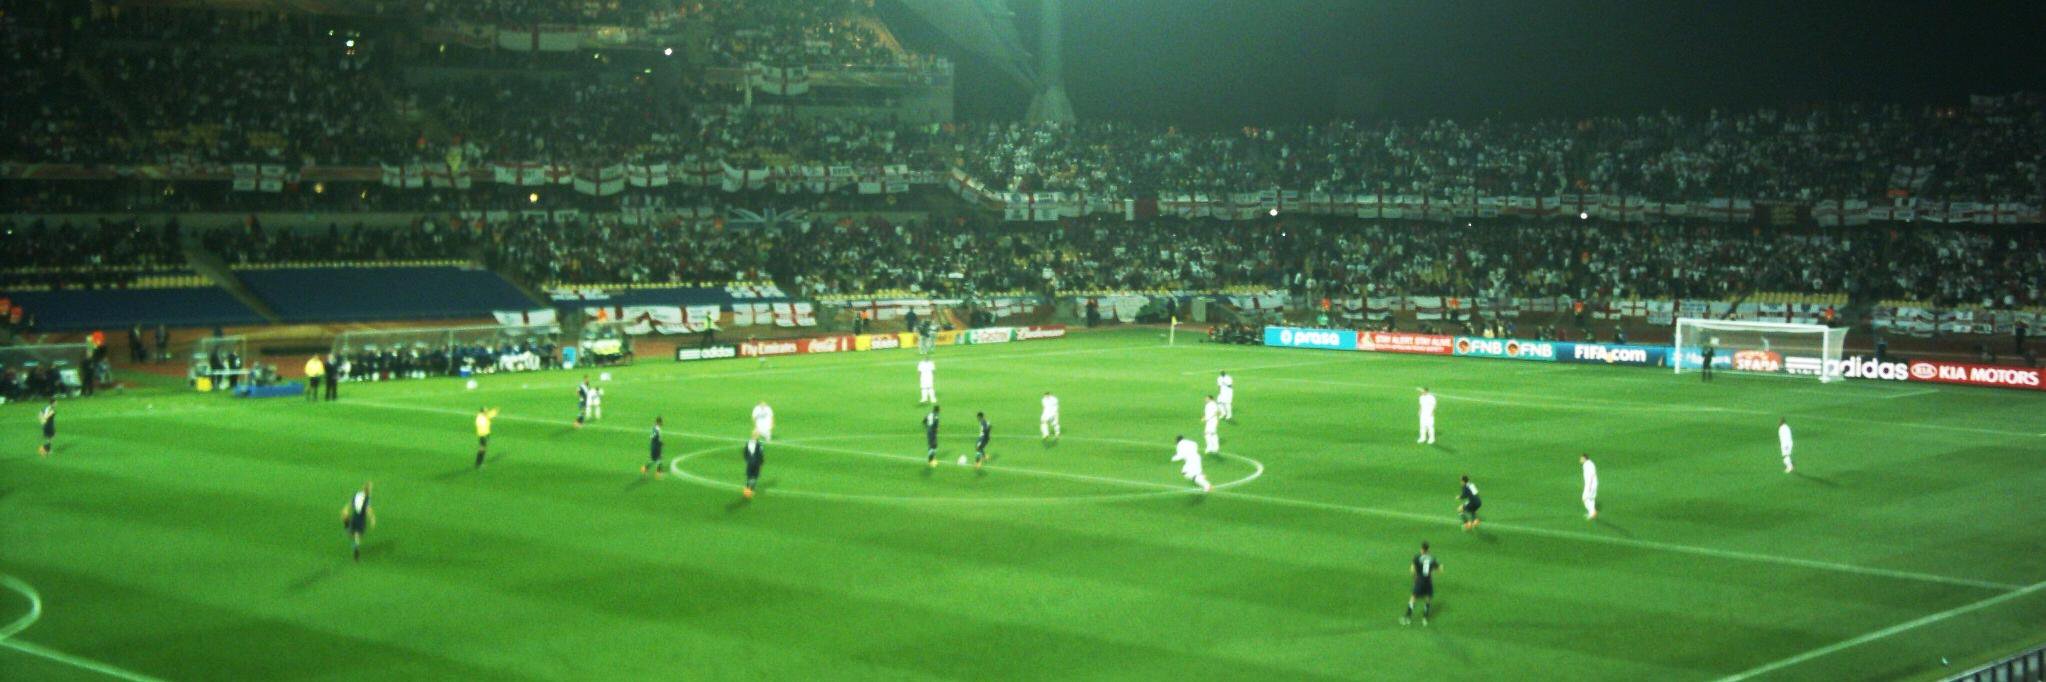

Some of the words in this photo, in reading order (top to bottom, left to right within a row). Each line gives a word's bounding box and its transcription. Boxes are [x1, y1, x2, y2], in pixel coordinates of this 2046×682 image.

[1294, 331, 1340, 346] prasa
[1471, 340, 1502, 354] FNB
[1520, 343, 1552, 357] FNB
[1574, 344, 1647, 362] FIFA.com
[1938, 365, 1967, 380] KIA
[1970, 367, 2040, 385] MOTORS
